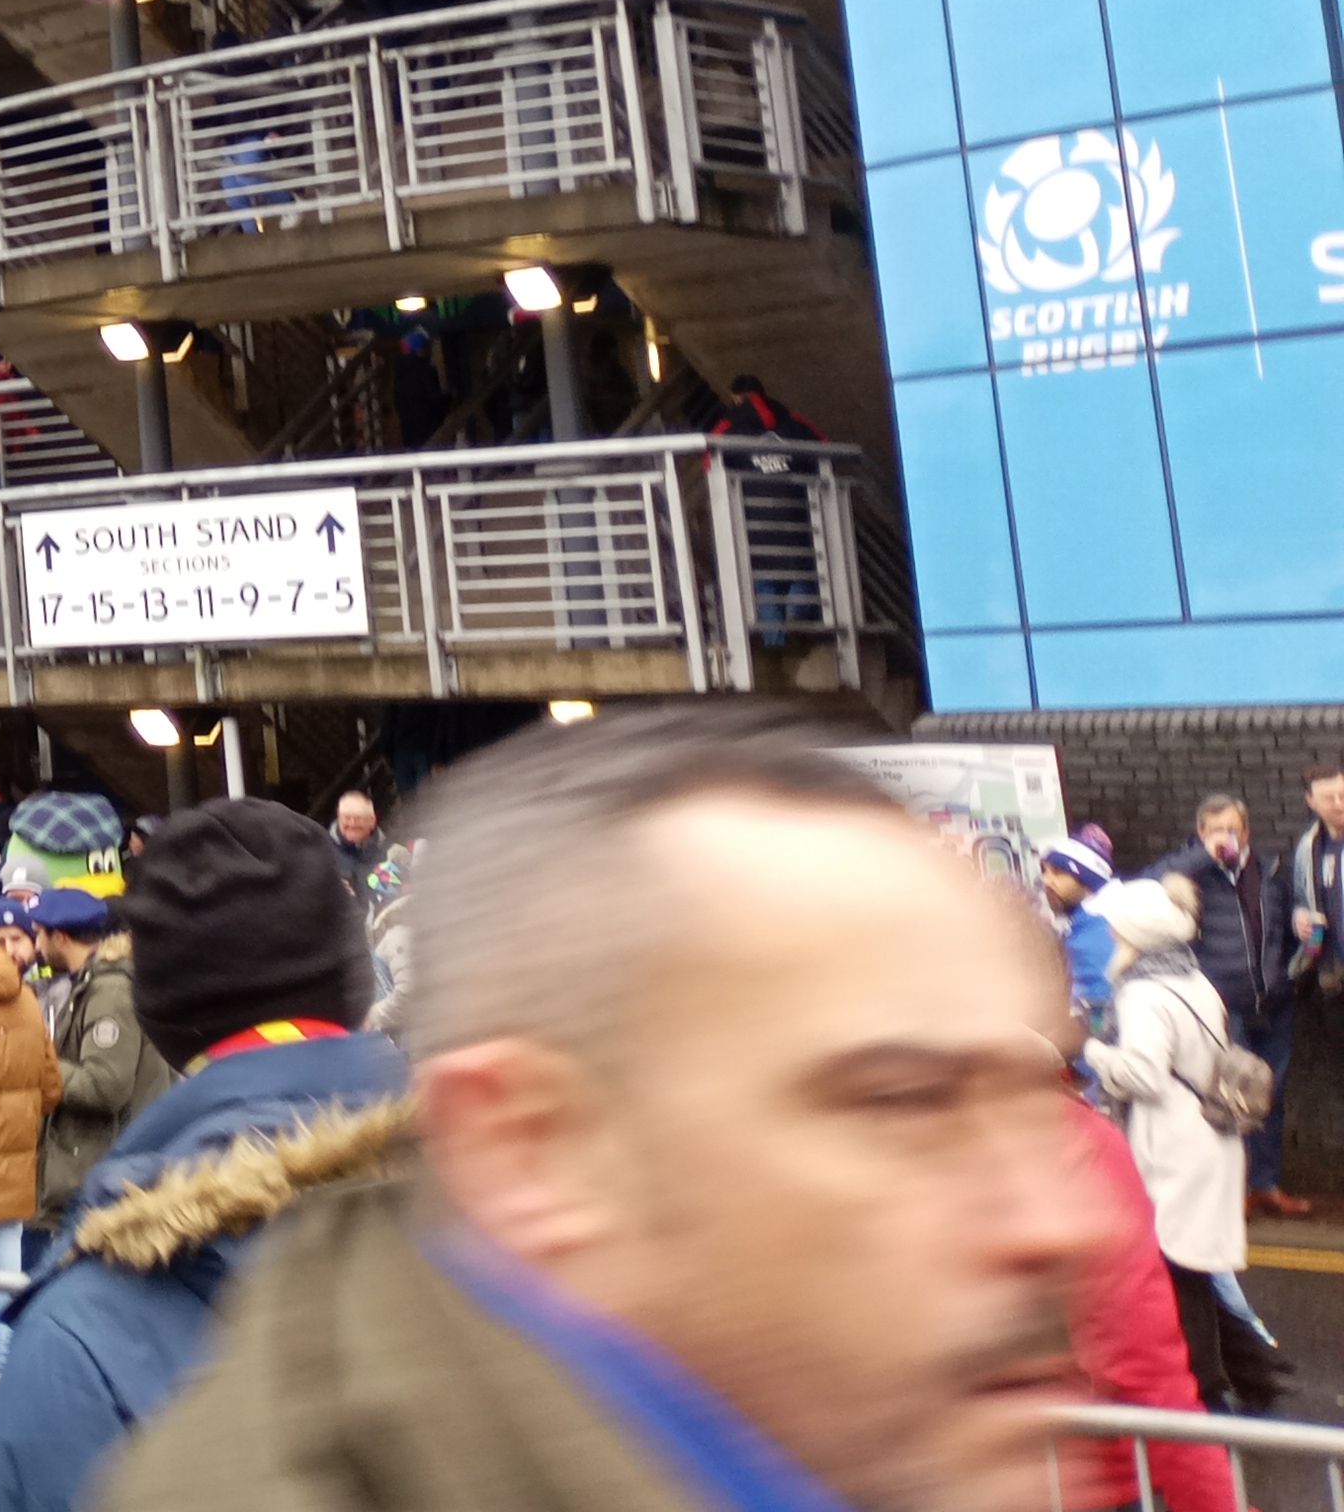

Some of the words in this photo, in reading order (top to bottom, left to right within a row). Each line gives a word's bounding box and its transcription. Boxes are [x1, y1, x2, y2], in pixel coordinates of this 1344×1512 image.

[990, 282, 1190, 342] SCOTTISH
[1021, 323, 1170, 378] RUGBY
[74, 521, 178, 556] SOUTH
[196, 512, 299, 548] STAND
[140, 554, 231, 576] SECTIONS
